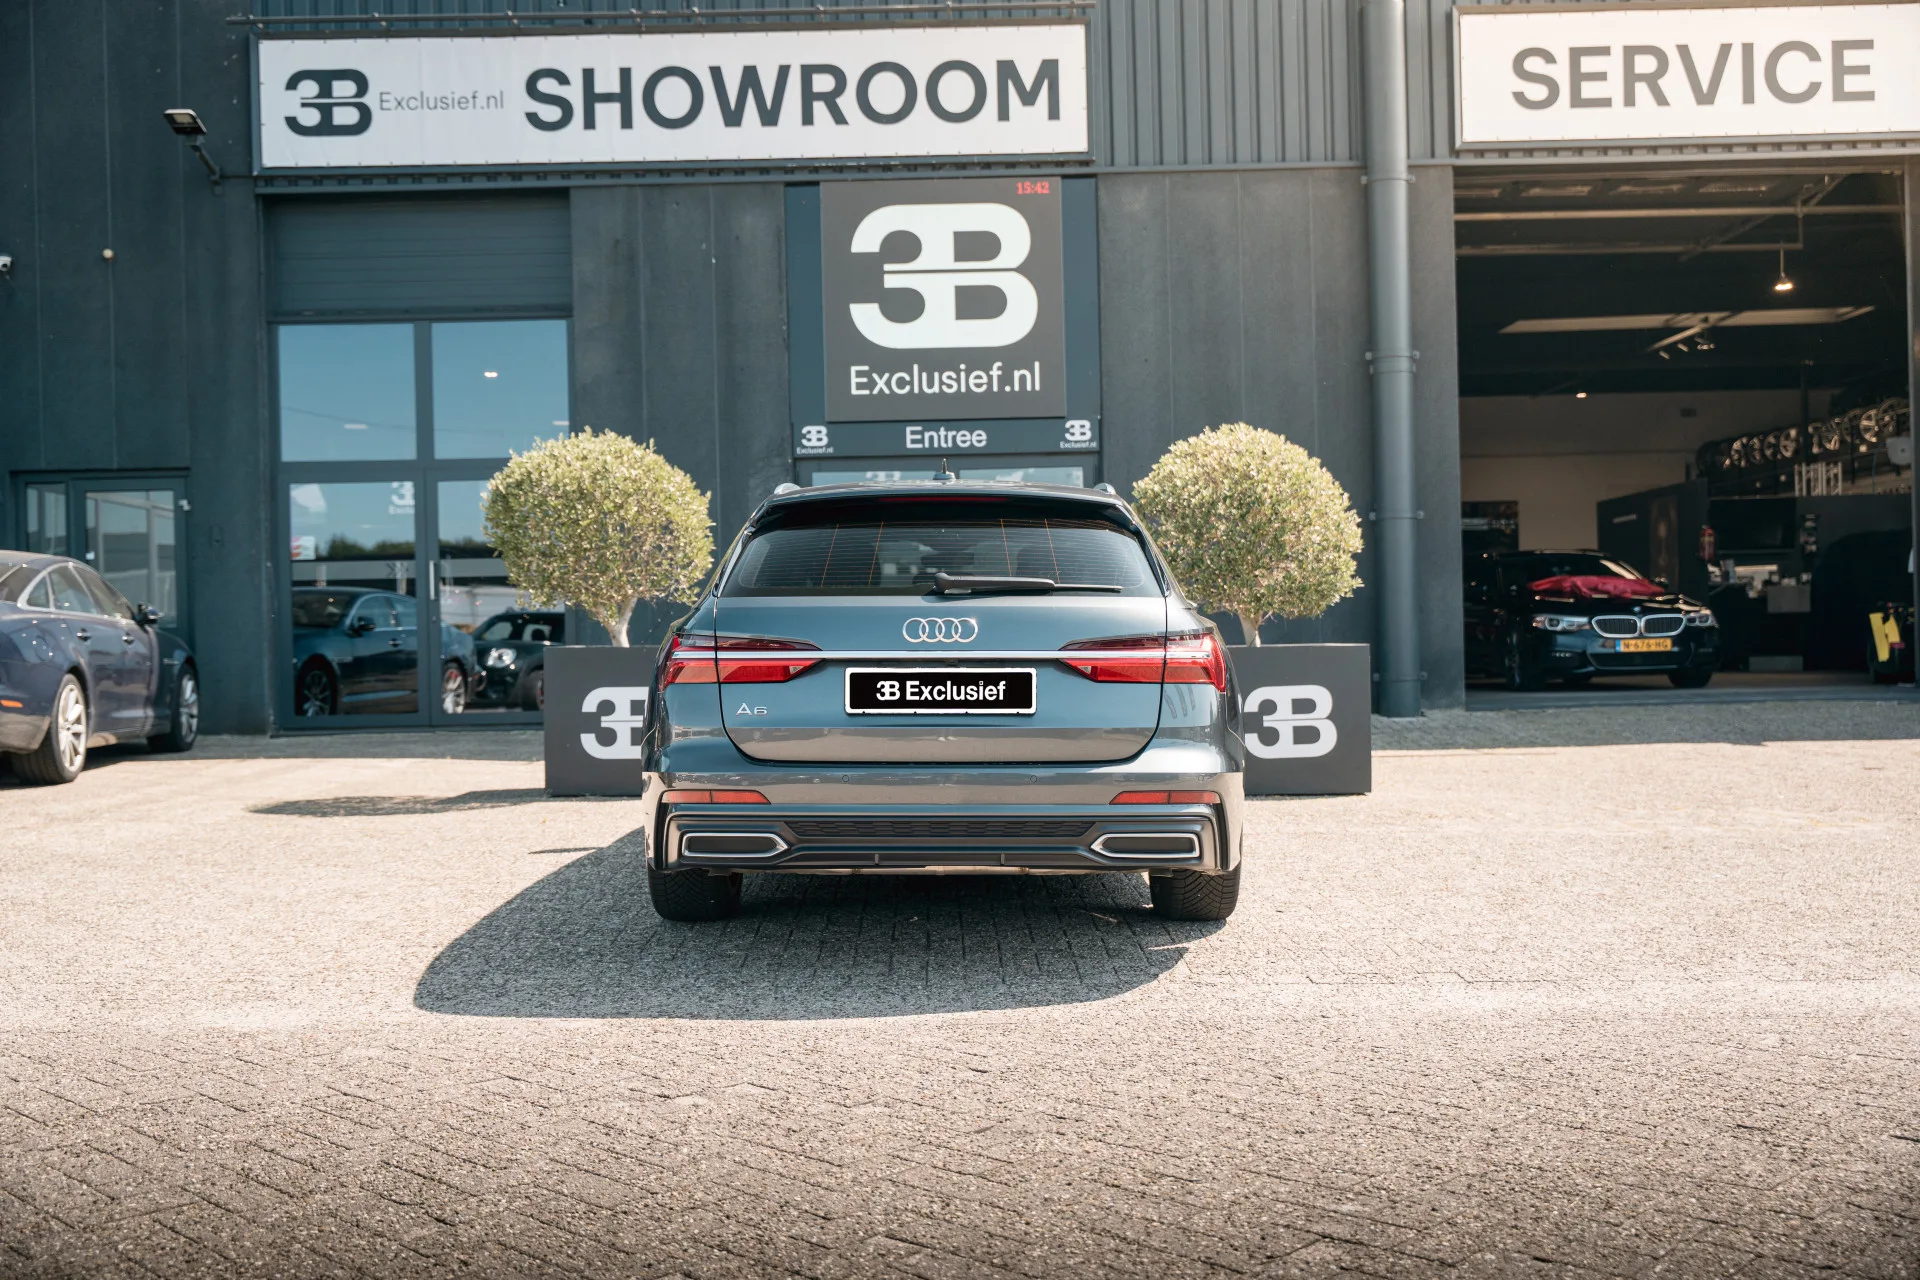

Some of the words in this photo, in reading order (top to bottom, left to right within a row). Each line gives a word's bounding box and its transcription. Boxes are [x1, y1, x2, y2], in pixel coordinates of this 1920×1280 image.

[1511, 39, 1875, 110] SERVICE
[285, 69, 372, 136] 3B
[379, 90, 504, 112] Exclusief.nl
[525, 58, 1061, 132] SHOWROOM
[1016, 181, 1050, 195] 15:42
[849, 202, 1039, 349] 3B
[850, 361, 1040, 395] Exclusief.nl
[801, 425, 828, 447] 3B
[905, 426, 987, 449] Entree
[1064, 419, 1092, 441] 3B
[876, 680, 900, 700] 3B
[905, 680, 1006, 700] Exclusief
[736, 702, 767, 716] A6
[1243, 684, 1338, 760] 3B
